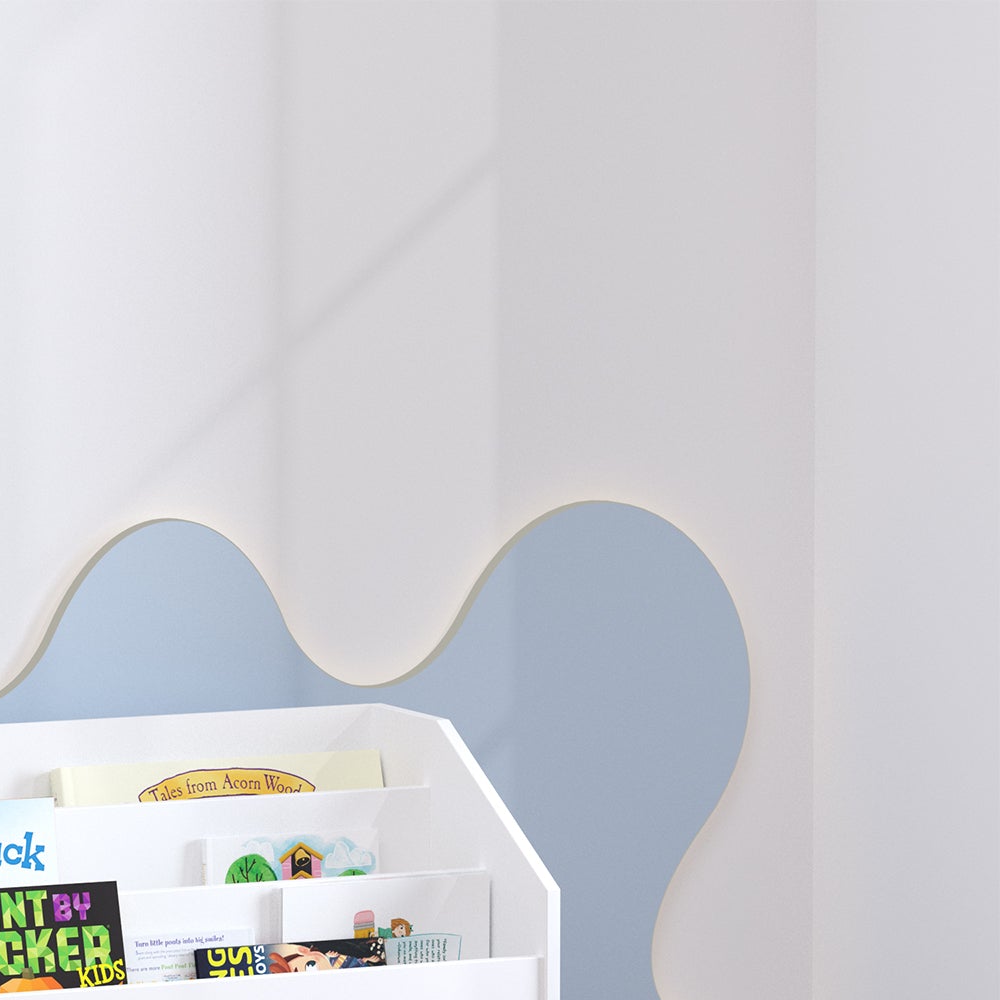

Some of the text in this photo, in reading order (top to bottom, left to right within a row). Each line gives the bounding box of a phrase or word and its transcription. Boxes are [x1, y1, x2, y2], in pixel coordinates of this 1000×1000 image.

[149, 773, 302, 802] Tales from Acorn Wood
[52, 891, 91, 922] BY
[76, 958, 126, 989] KIDS
